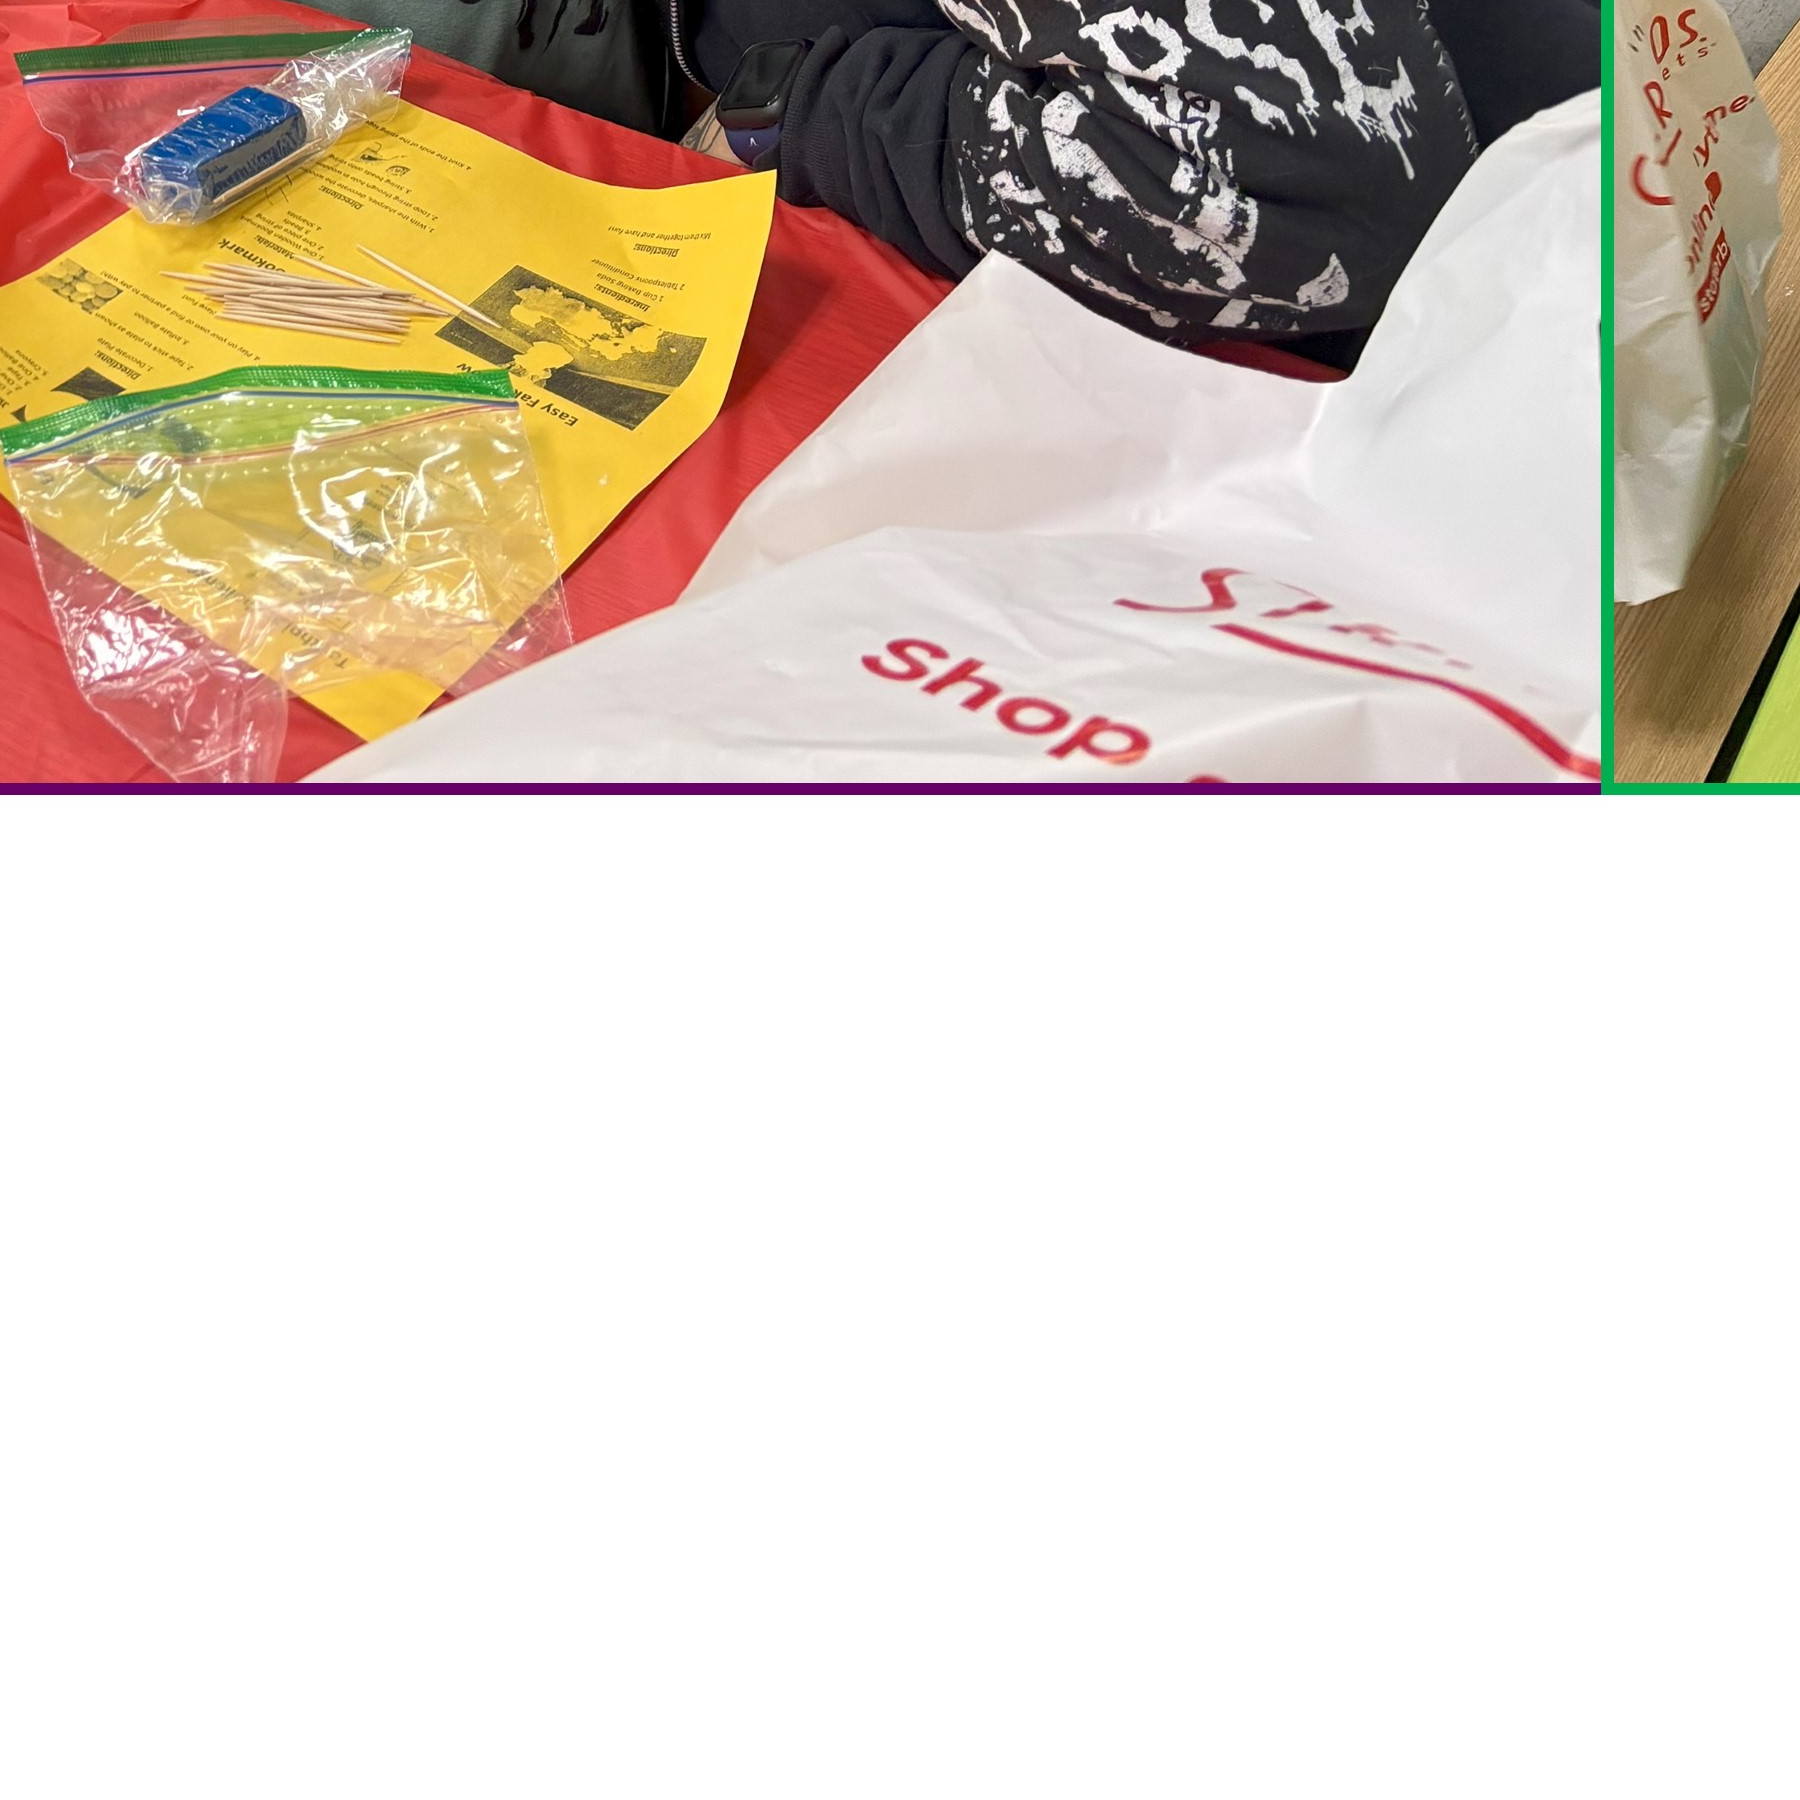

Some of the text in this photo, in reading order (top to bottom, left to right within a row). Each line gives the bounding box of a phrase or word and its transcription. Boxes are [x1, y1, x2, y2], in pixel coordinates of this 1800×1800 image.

[379, 126, 465, 168] Knot the ends the string
[347, 162, 364, 173] onto
[363, 169, 385, 184] beads
[336, 182, 367, 200] decorate
[385, 178, 405, 192] String
[318, 185, 364, 211] Directions:
[349, 175, 431, 218] Loop string through hole
[282, 218, 304, 232] Beads
[286, 210, 316, 228] Sharpies
[397, 212, 410, 220] the
[409, 218, 427, 231] With
[254, 212, 317, 248] One piece string
[641, 231, 655, 239] and
[655, 233, 684, 241] together
[254, 235, 295, 260] Materials:
[273, 232, 302, 250] Wooden
[301, 247, 318, 258] One
[633, 243, 680, 258] Directions:
[591, 258, 679, 290] Tablespoons Conditioner
[596, 272, 658, 301] Cup Baking Soda
[140, 291, 167, 310] partner
[593, 283, 650, 312] Ingredients:
[170, 310, 185, 322] find
[133, 312, 182, 343] Inflate Balloon
[94, 312, 186, 368] Tape stick plate shown
[209, 332, 227, 344] your
[96, 337, 147, 369] Decorate Plate
[237, 346, 254, 358] Play
[7, 366, 24, 382] Tape
[93, 350, 141, 380] Directions:
[0, 374, 16, 387] One
[514, 389, 578, 426] Easy Fak
[861, 637, 1152, 767] Shop
